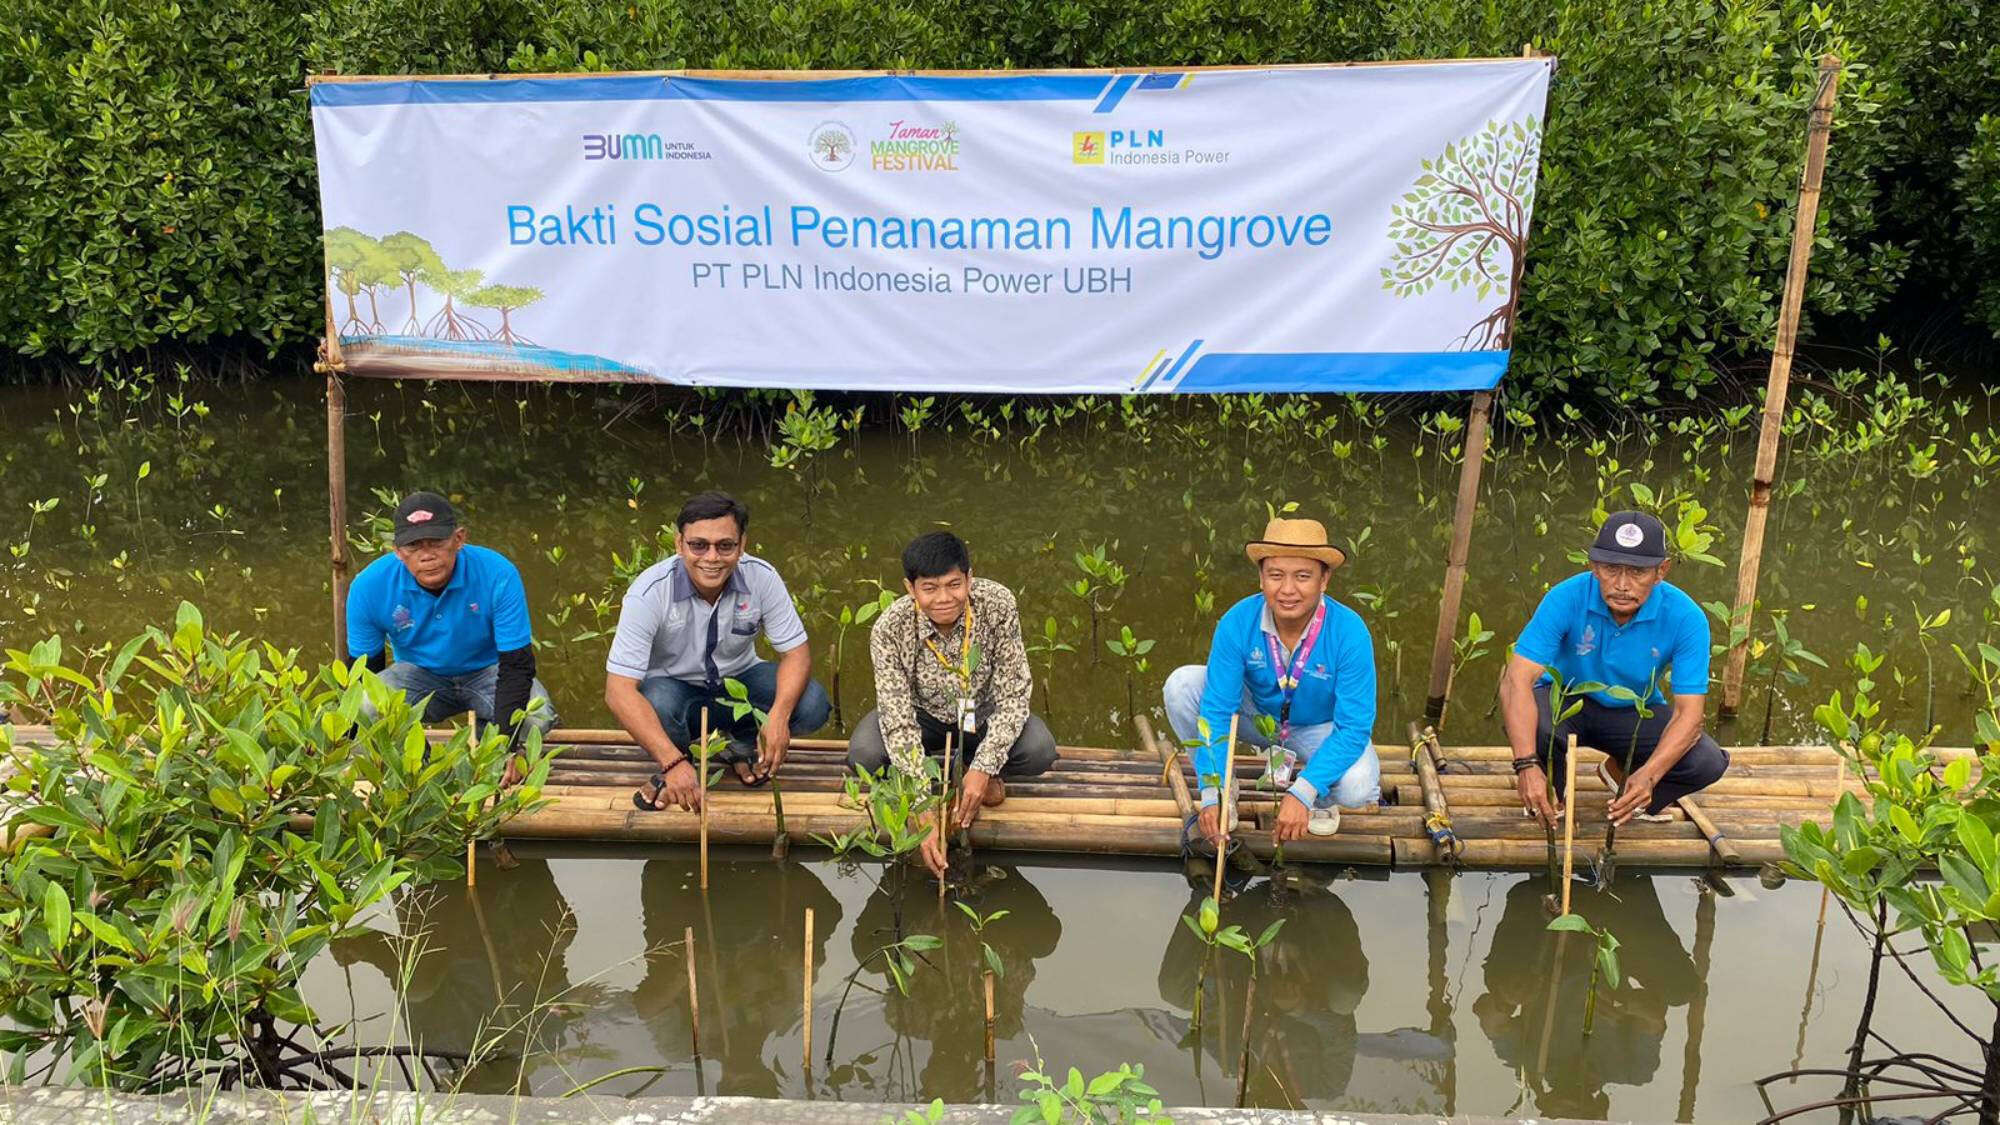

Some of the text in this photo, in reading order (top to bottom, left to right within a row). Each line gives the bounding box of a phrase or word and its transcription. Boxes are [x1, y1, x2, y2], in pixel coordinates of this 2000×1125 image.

[889, 120, 941, 139] Taman
[1111, 129, 1163, 148] PLN
[666, 152, 712, 160] INDONESIA
[871, 140, 960, 155] MANGROVE
[872, 154, 960, 171] FESTIVAL
[1110, 149, 1230, 165] Indonesia Power
[507, 203, 1332, 260] Bakti Sosial Penanaman Mangrove
[692, 263, 1132, 294] PT PLN Indonesia Power UBH
